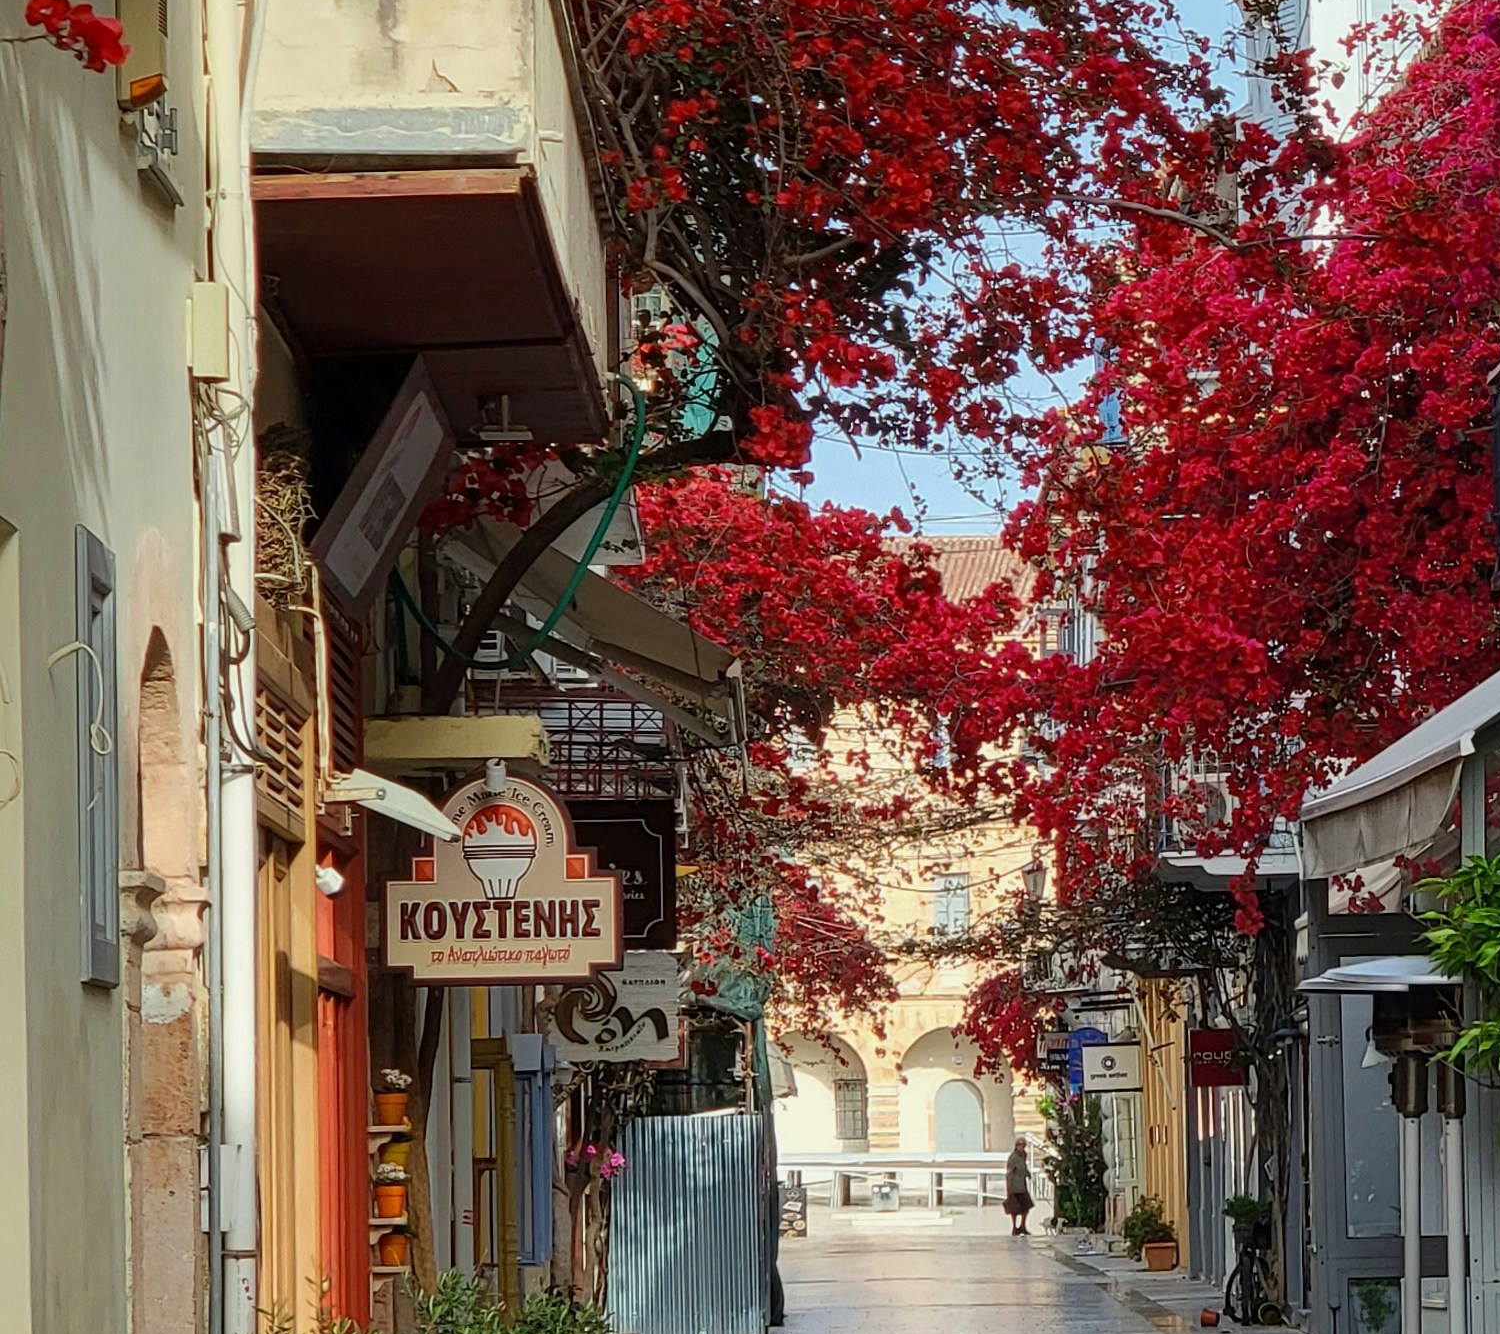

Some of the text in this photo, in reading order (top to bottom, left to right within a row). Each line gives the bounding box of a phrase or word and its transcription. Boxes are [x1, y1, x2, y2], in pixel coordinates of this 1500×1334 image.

[509, 787, 530, 804] Ice
[532, 801, 555, 847] Cream
[400, 898, 601, 941] ΚΟΥΣΤΕΝΗΣ
[525, 943, 571, 968] παγωτό
